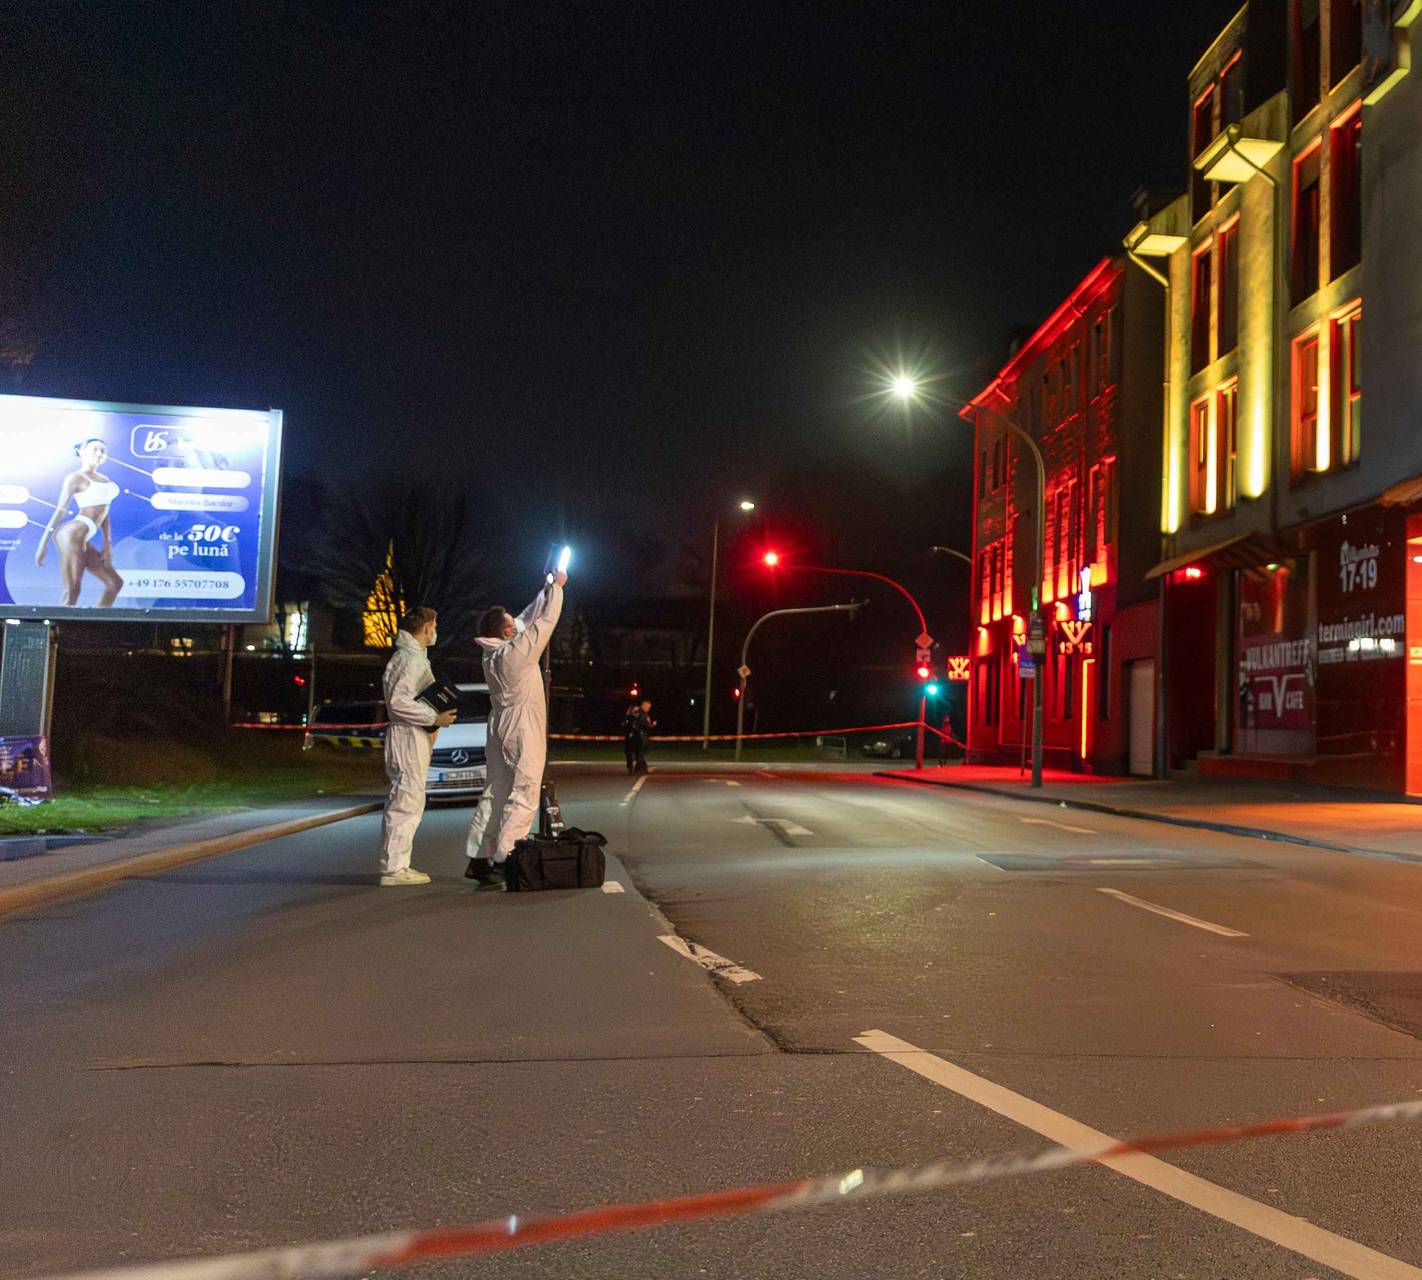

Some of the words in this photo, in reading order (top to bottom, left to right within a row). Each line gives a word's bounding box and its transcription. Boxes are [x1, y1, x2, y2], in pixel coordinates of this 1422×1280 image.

[187, 524, 240, 543] 50€
[168, 545, 189, 559] pe
[193, 542, 229, 557] lună
[153, 578, 171, 588] 176
[1318, 612, 1405, 642] termingirl.com
